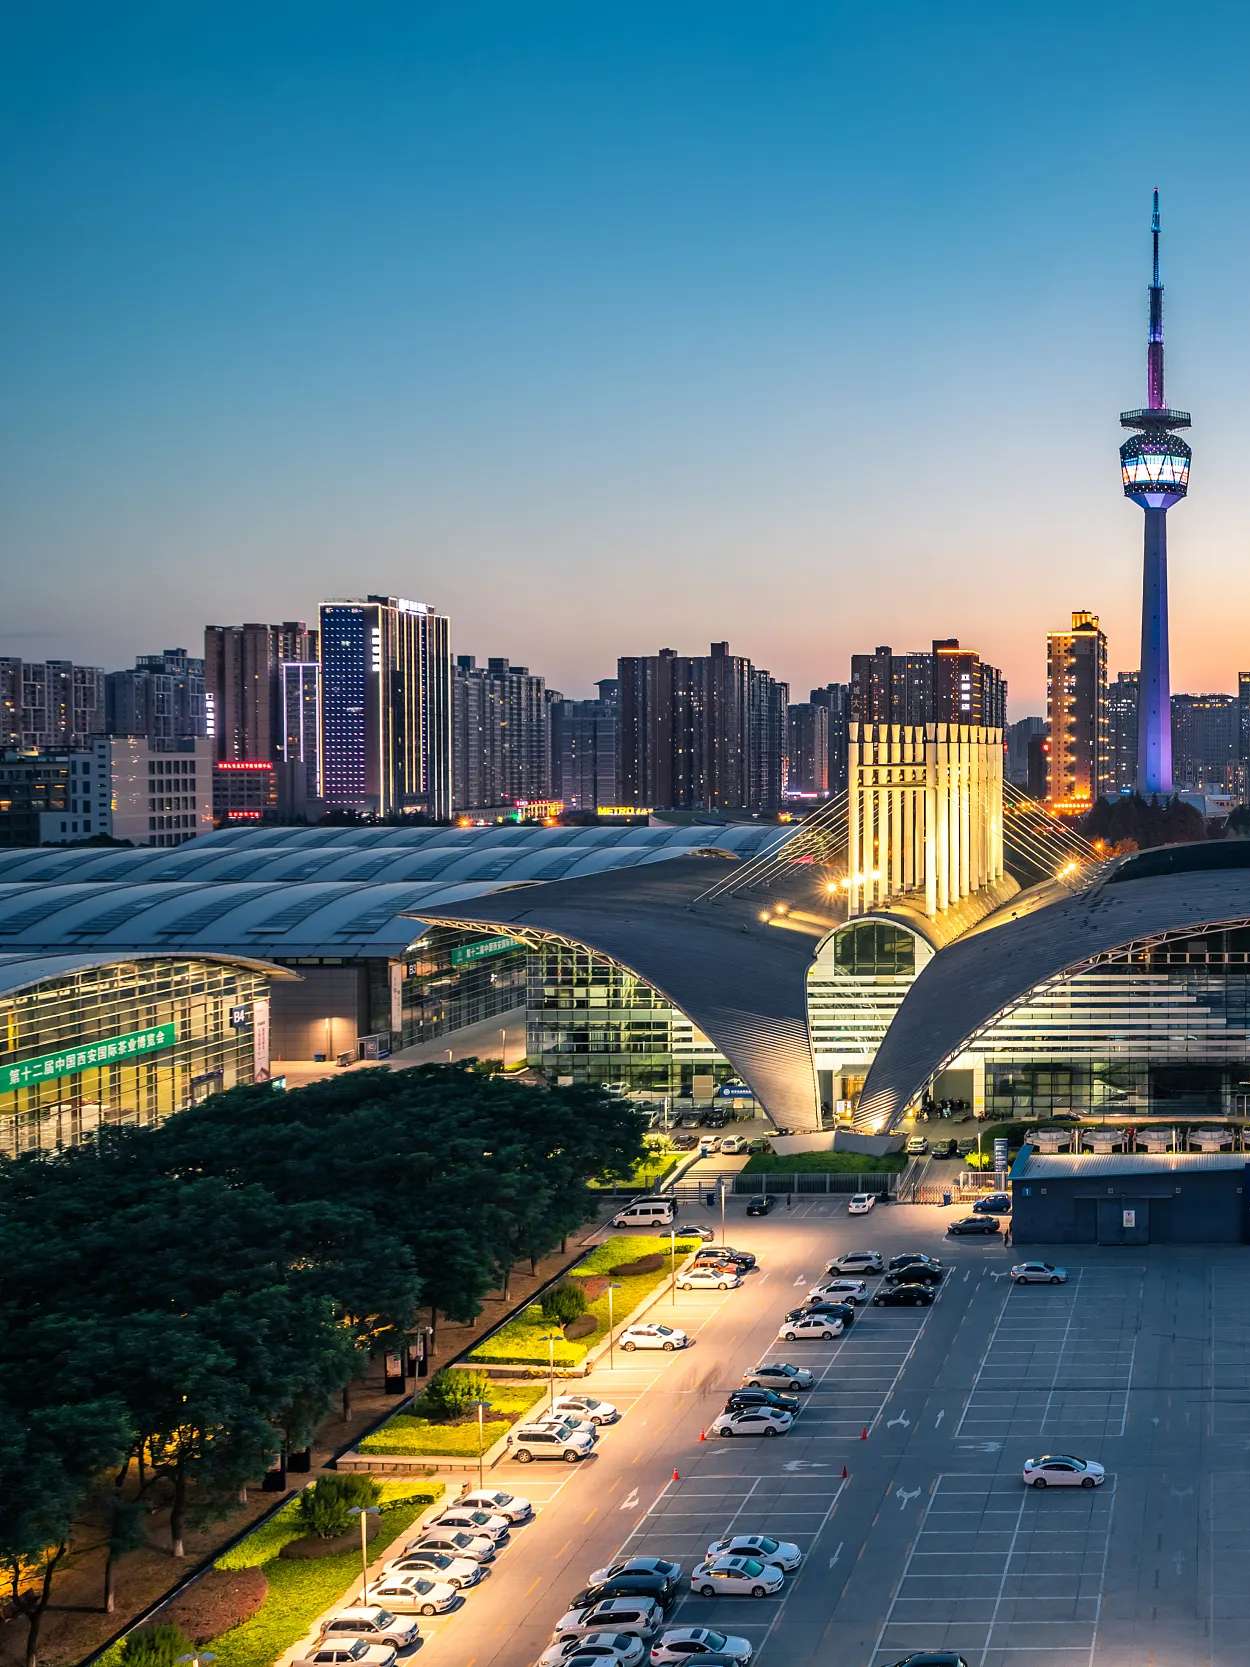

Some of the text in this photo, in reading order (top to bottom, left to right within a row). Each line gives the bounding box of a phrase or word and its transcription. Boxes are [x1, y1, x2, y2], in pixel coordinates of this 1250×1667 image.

[598, 806, 635, 815] METRO
[233, 1010, 244, 1023] B4
[9, 1031, 165, 1084] 第十二届中国西安国际茶业博览会
